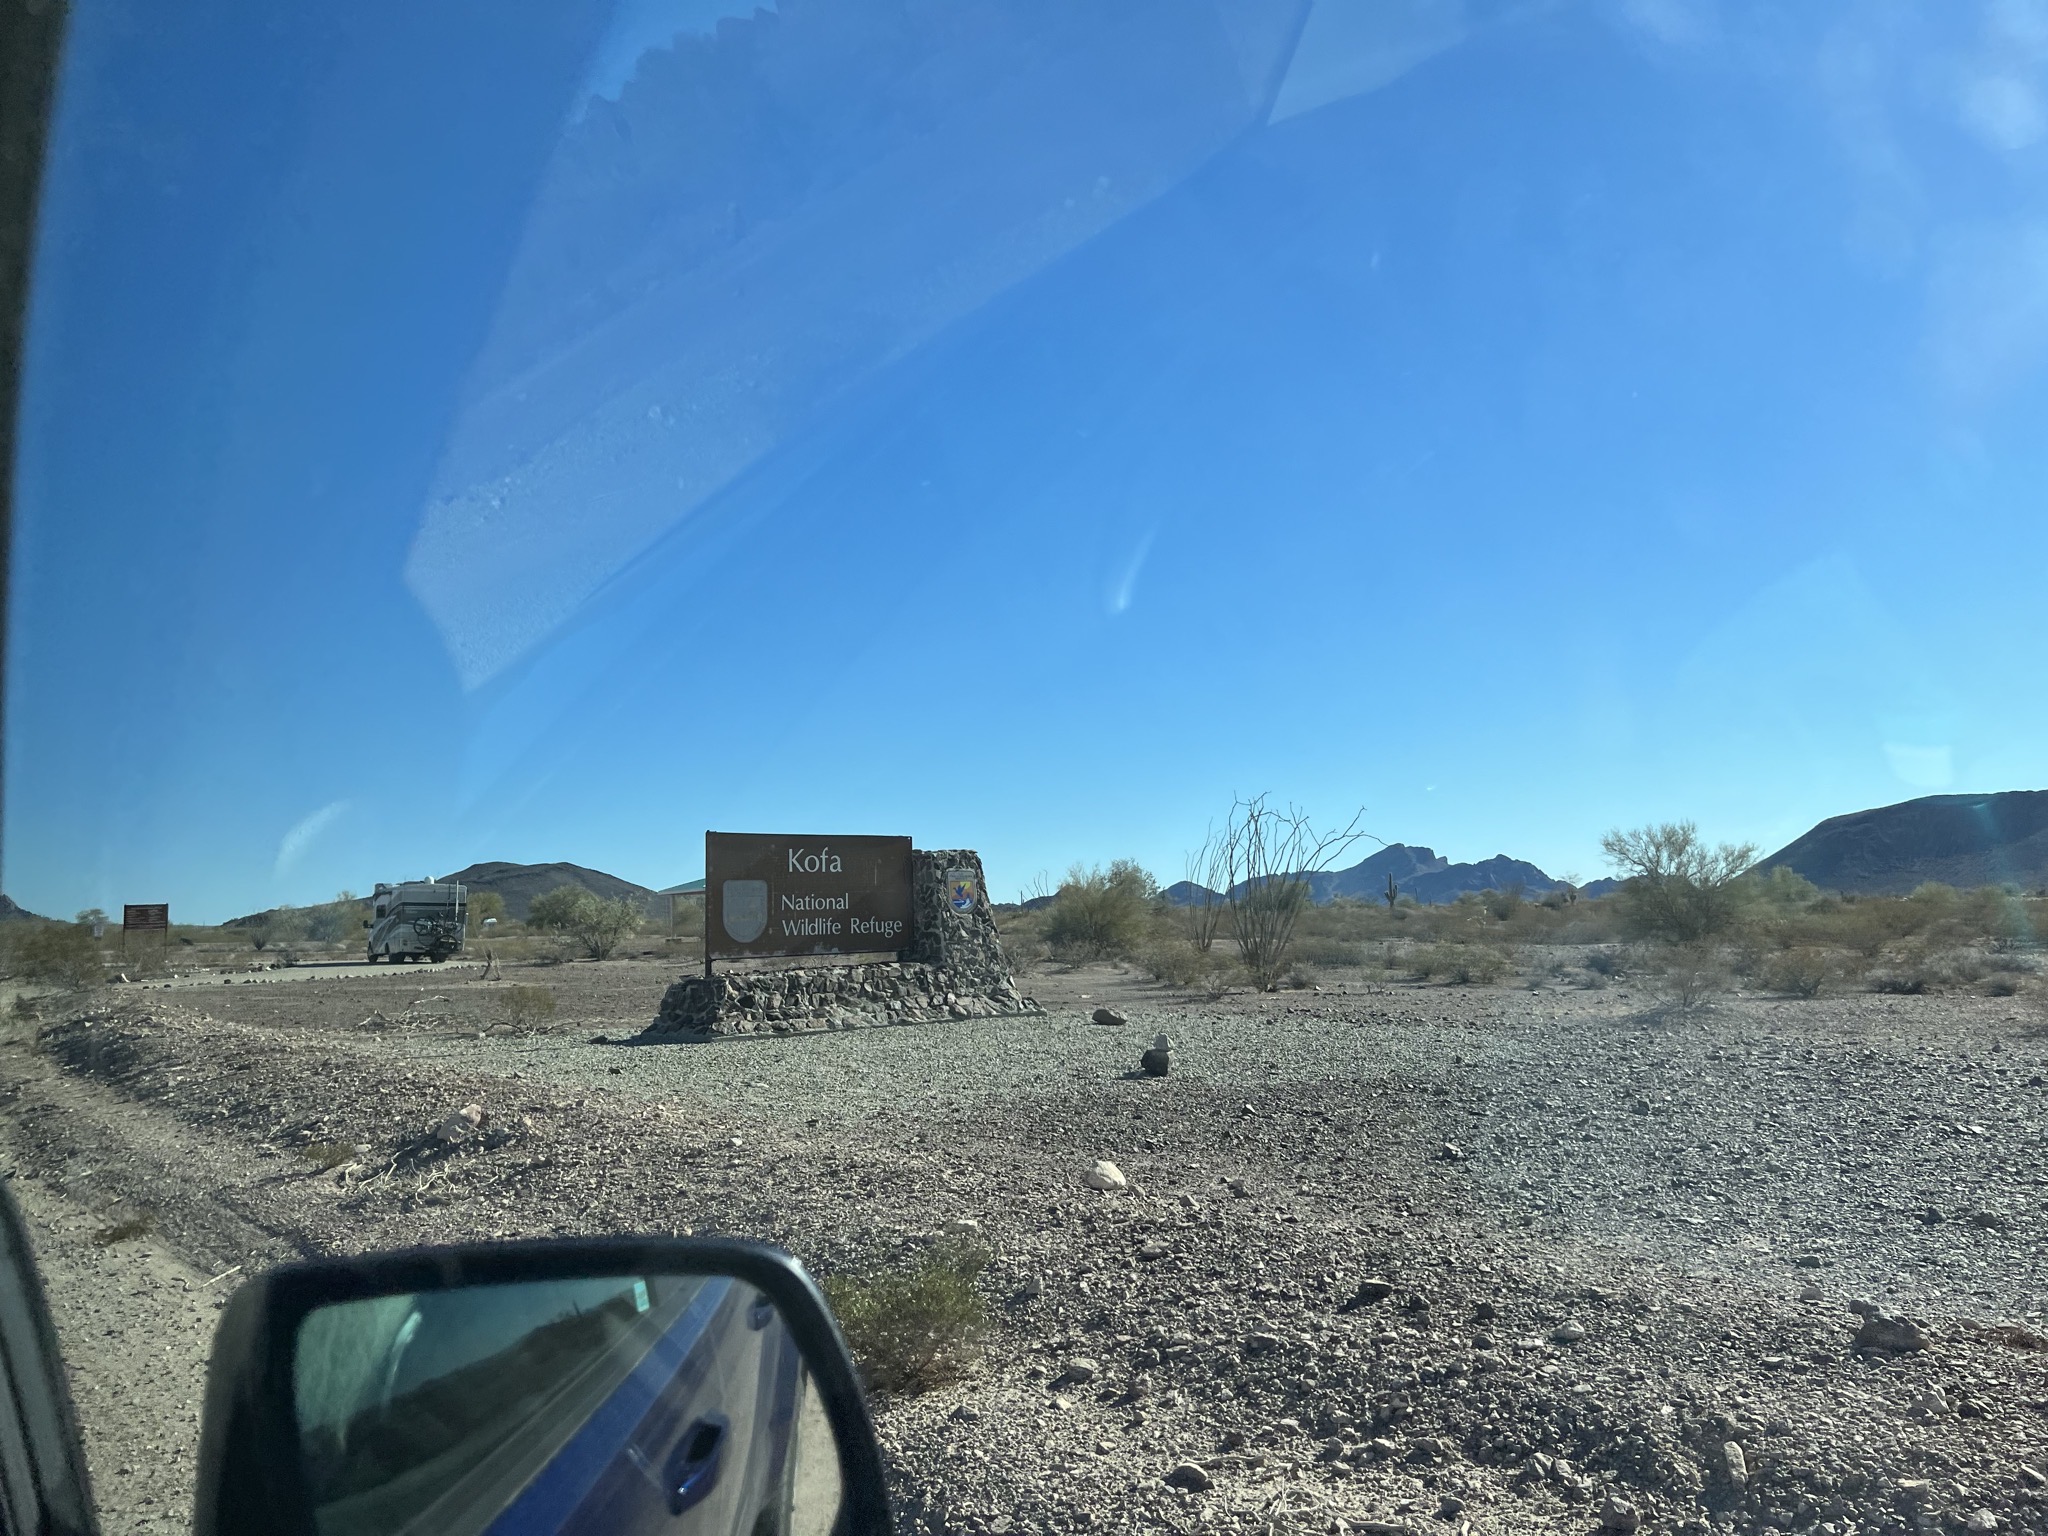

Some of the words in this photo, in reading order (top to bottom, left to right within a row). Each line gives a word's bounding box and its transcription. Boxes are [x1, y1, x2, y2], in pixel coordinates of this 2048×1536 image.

[788, 847, 842, 873] Kofa
[781, 893, 849, 910] National
[782, 917, 841, 936] Wildlife
[850, 916, 903, 938] Refuge
